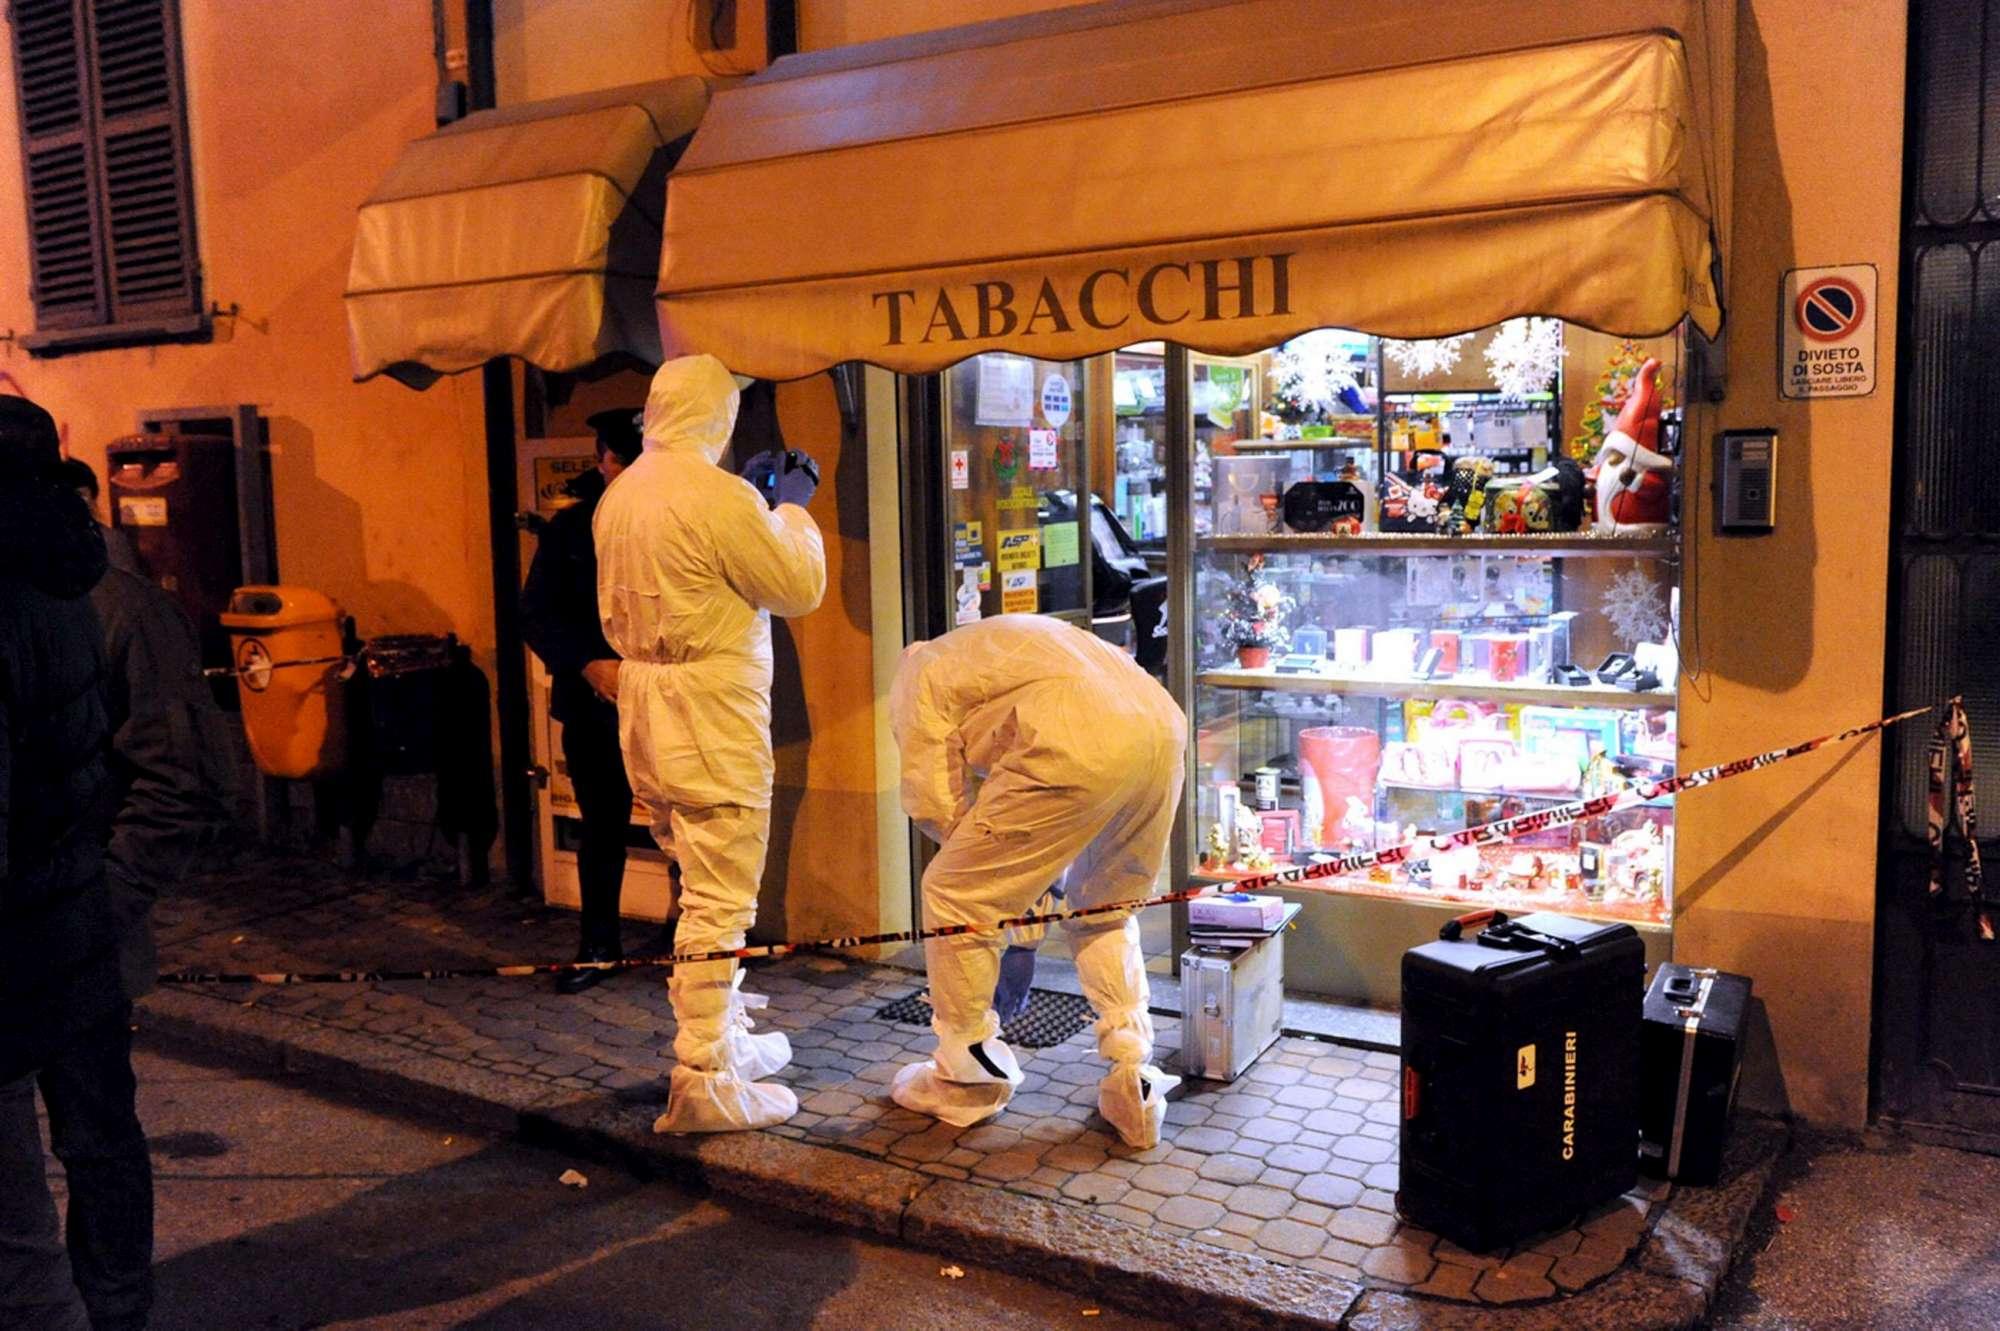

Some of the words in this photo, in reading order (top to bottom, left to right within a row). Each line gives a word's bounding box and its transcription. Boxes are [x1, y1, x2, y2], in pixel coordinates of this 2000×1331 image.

[872, 253, 1296, 347] TABACCHI
[1793, 364, 1808, 376] DI
[1812, 361, 1865, 375] SOSTA
[1798, 347, 1860, 362] DIVIETO
[1562, 1031, 1577, 1160] CARABINIERI
